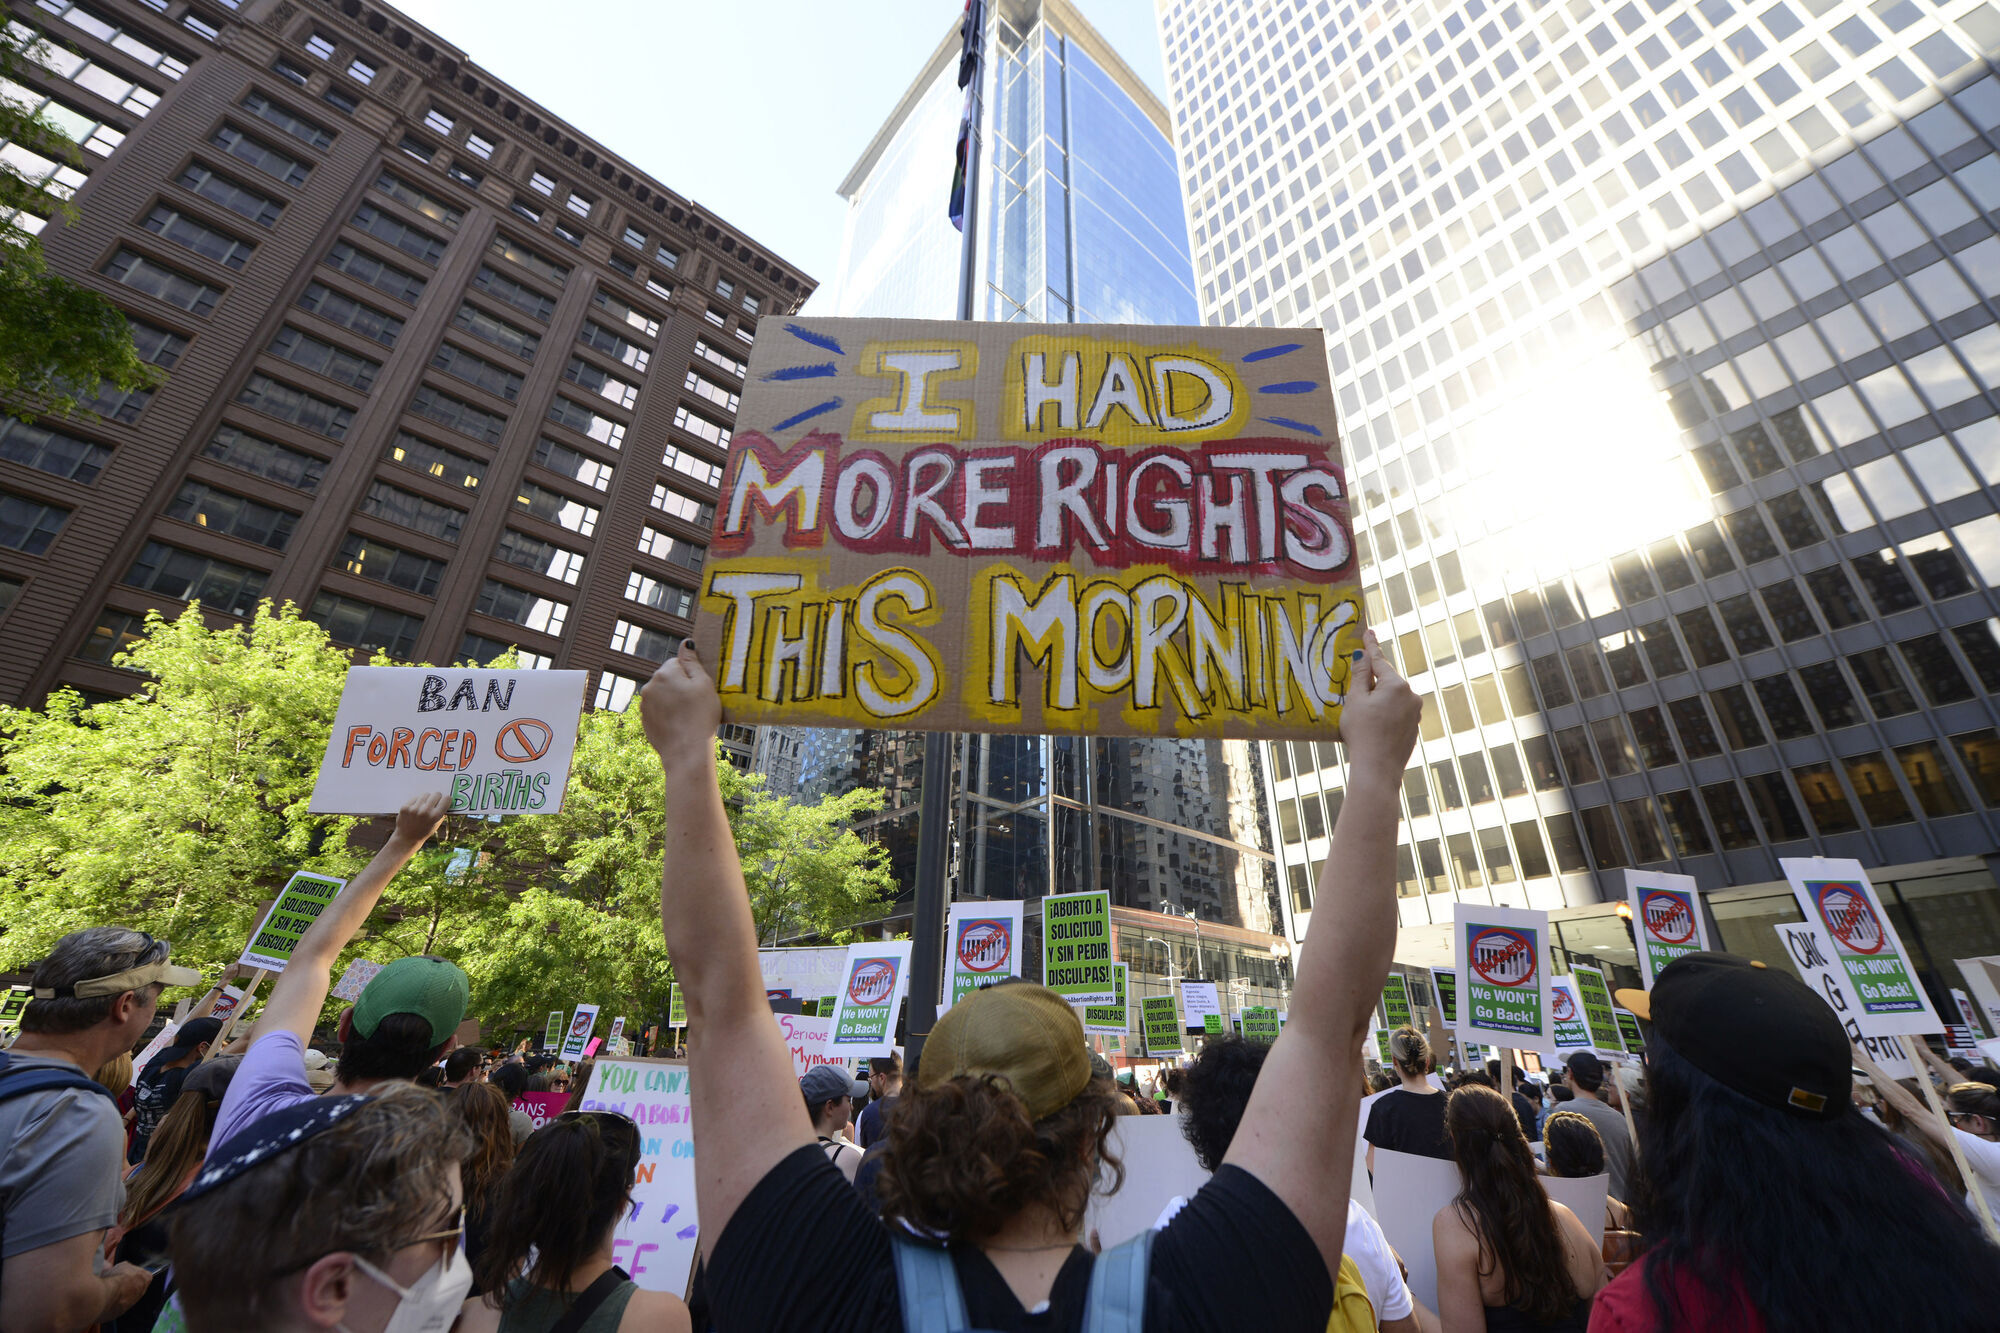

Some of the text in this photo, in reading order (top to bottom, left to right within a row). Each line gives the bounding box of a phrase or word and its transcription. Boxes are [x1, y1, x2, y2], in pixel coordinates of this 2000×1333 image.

[871, 349, 1234, 433] I HAD
[722, 447, 1351, 573] MORE RIGHTS
[708, 566, 1362, 721] THIS MORNING
[417, 675, 516, 712] BAN
[342, 725, 477, 771] FORCED
[450, 770, 550, 811] BIRTHS
[325, 886, 336, 899] A
[281, 897, 325, 917] SOLICITUD
[1050, 898, 1103, 919] ¡ABORTO A
[267, 914, 312, 934] Y SIN PED
[1051, 920, 1103, 940] SOLICITUD
[255, 932, 299, 953] DISCULPA
[964, 928, 1003, 962] BIASED
[1048, 942, 1108, 963] Y SIN PEDIR
[1649, 945, 1666, 956] We
[1479, 940, 1525, 974] BIASED
[1844, 959, 1904, 975] We WON'T
[956, 976, 971, 987] We
[1048, 966, 1110, 986] DISCULPAS!
[1471, 987, 1491, 1000] We
[1494, 989, 1538, 1005] WON'T
[1860, 983, 1880, 999] Go
[1881, 982, 1912, 998] Back!
[842, 1008, 889, 1019] We WON'T
[1086, 1008, 1125, 1021] DISCULPAS!
[1476, 1005, 1534, 1023] Go Back!
[841, 1023, 882, 1034] Go Back!
[791, 1046, 811, 1073] My
[599, 1064, 639, 1094] YOU
[631, 1103, 690, 1125] ABORT
